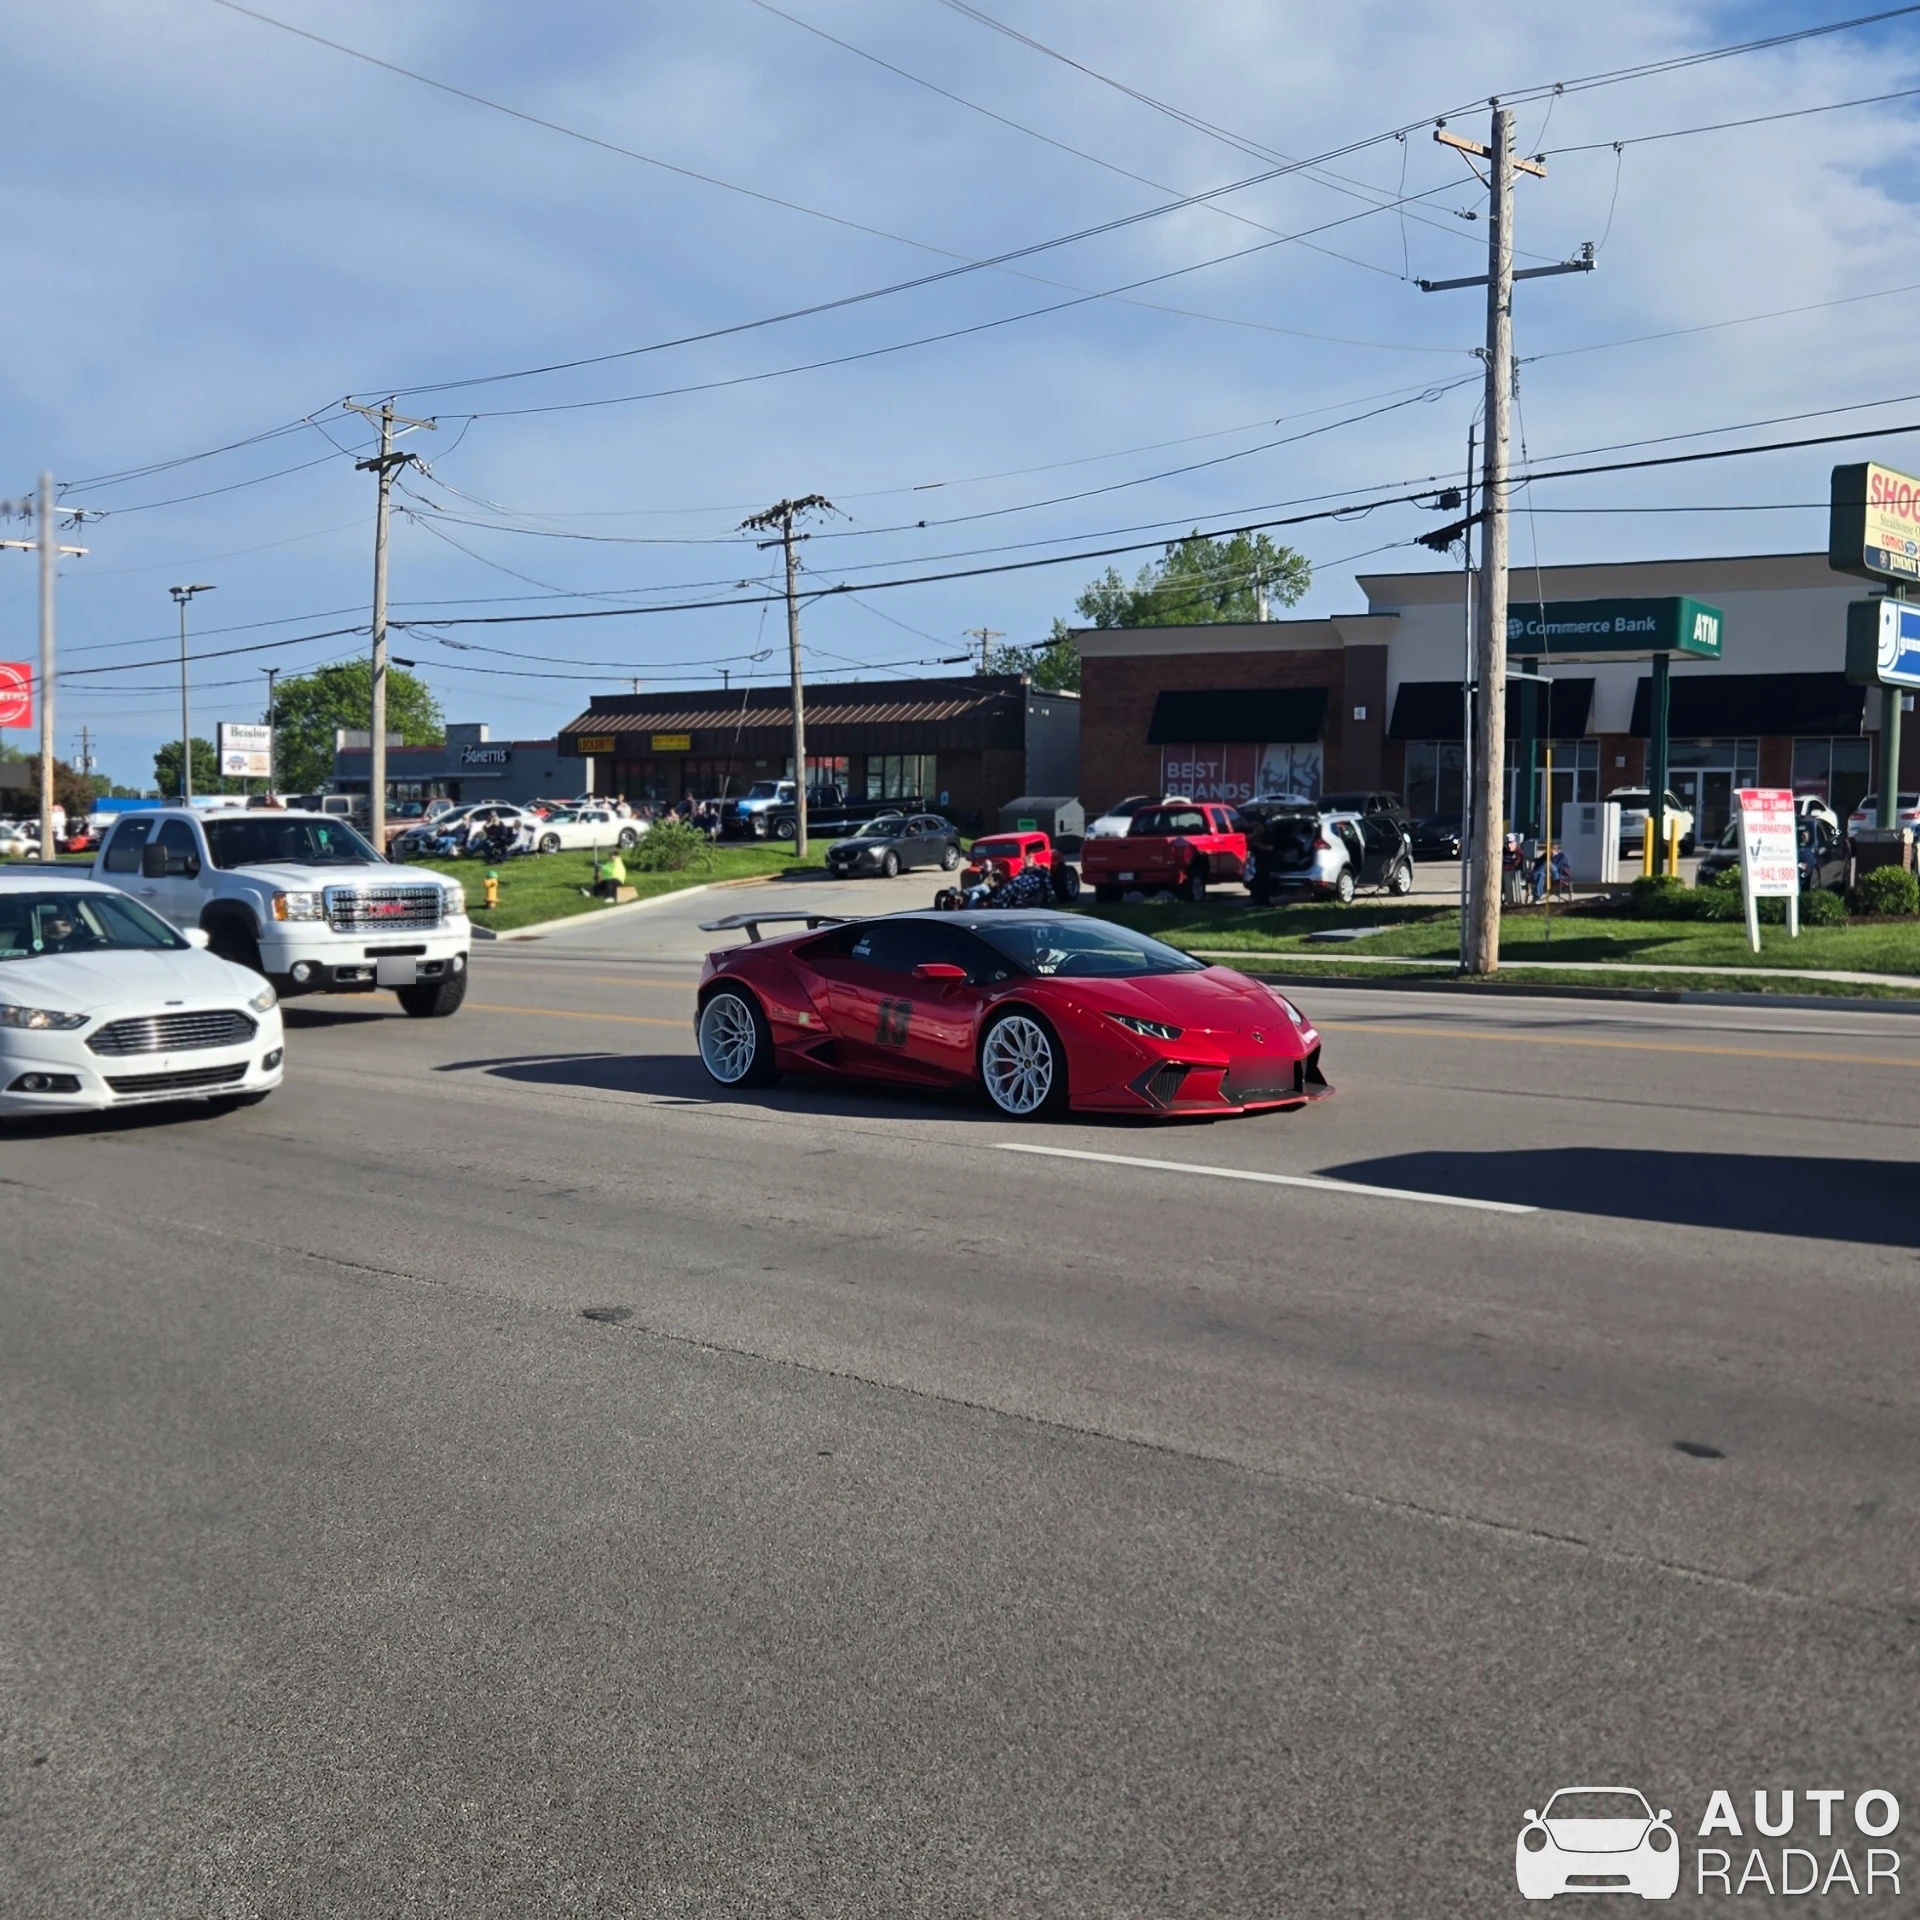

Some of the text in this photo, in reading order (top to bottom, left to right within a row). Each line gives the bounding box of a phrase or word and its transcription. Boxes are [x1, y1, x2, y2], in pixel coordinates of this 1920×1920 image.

[1890, 552, 1917, 573] JIMMY
[1526, 616, 1656, 636] Commerce Bank
[1693, 613, 1718, 646] ATM
[1167, 762, 1218, 779] BEST
[1167, 783, 1250, 799] BRANDS
[1748, 823, 1792, 834] INFORMATION
[876, 997, 912, 1047] 13
